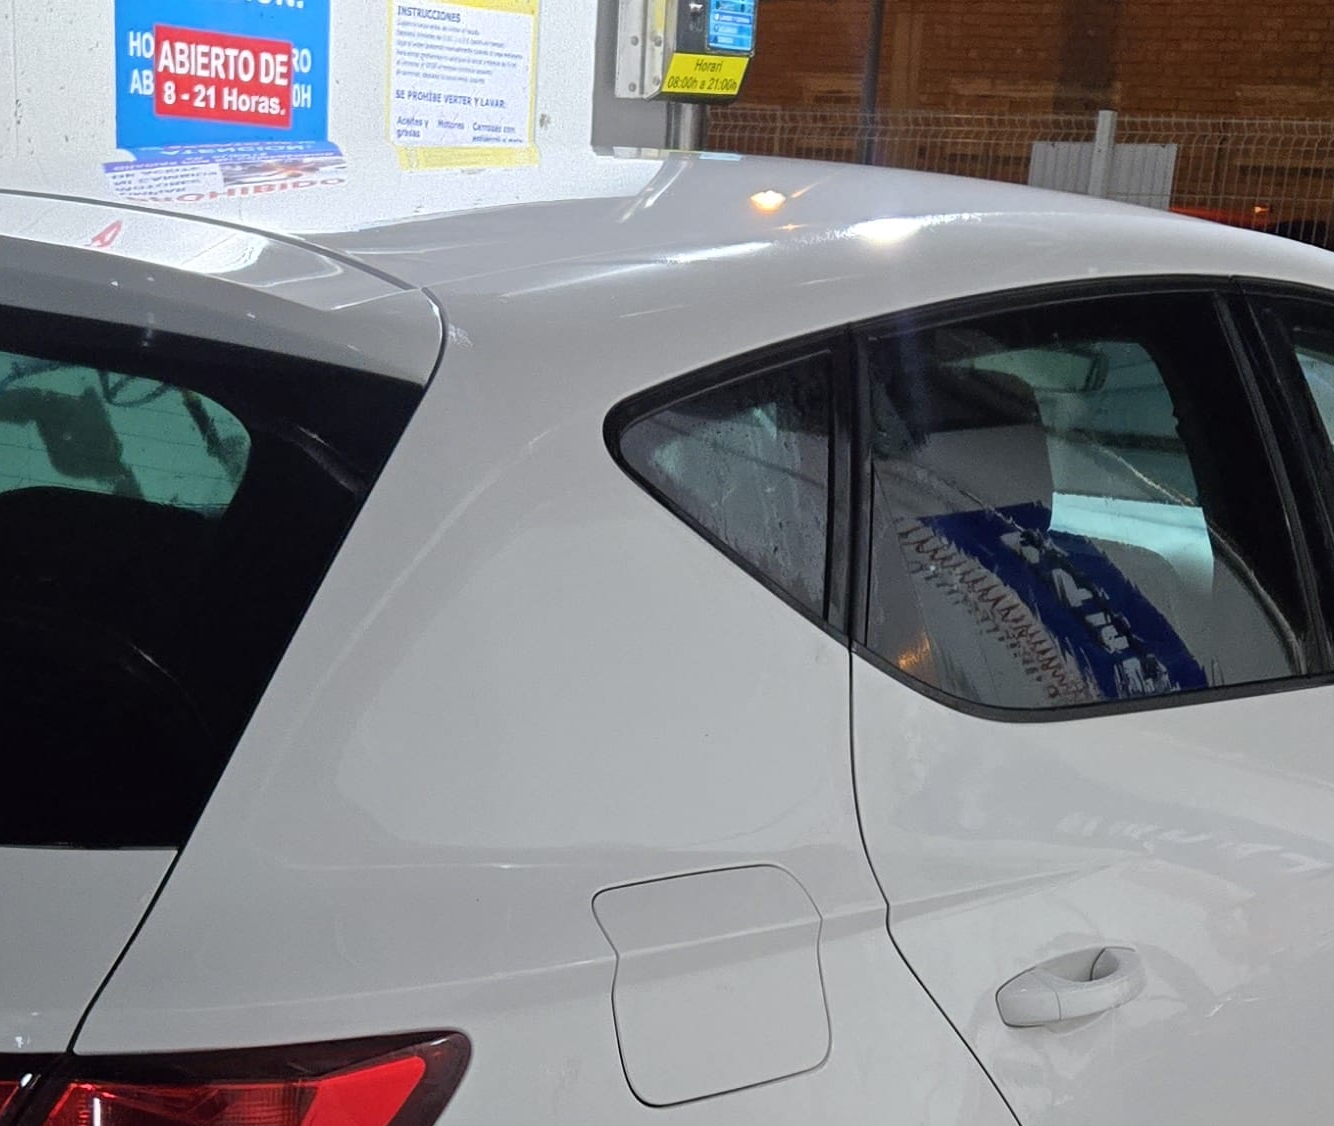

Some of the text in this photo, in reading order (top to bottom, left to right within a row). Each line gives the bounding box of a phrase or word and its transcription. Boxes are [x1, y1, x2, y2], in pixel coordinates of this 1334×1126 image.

[397, 5, 461, 23] INSTRUCCIONES
[157, 39, 289, 86] ABIERTO DE
[163, 81, 176, 105] 8
[193, 83, 216, 109] 21
[222, 87, 287, 116] Horas.
[395, 89, 405, 100] SE
